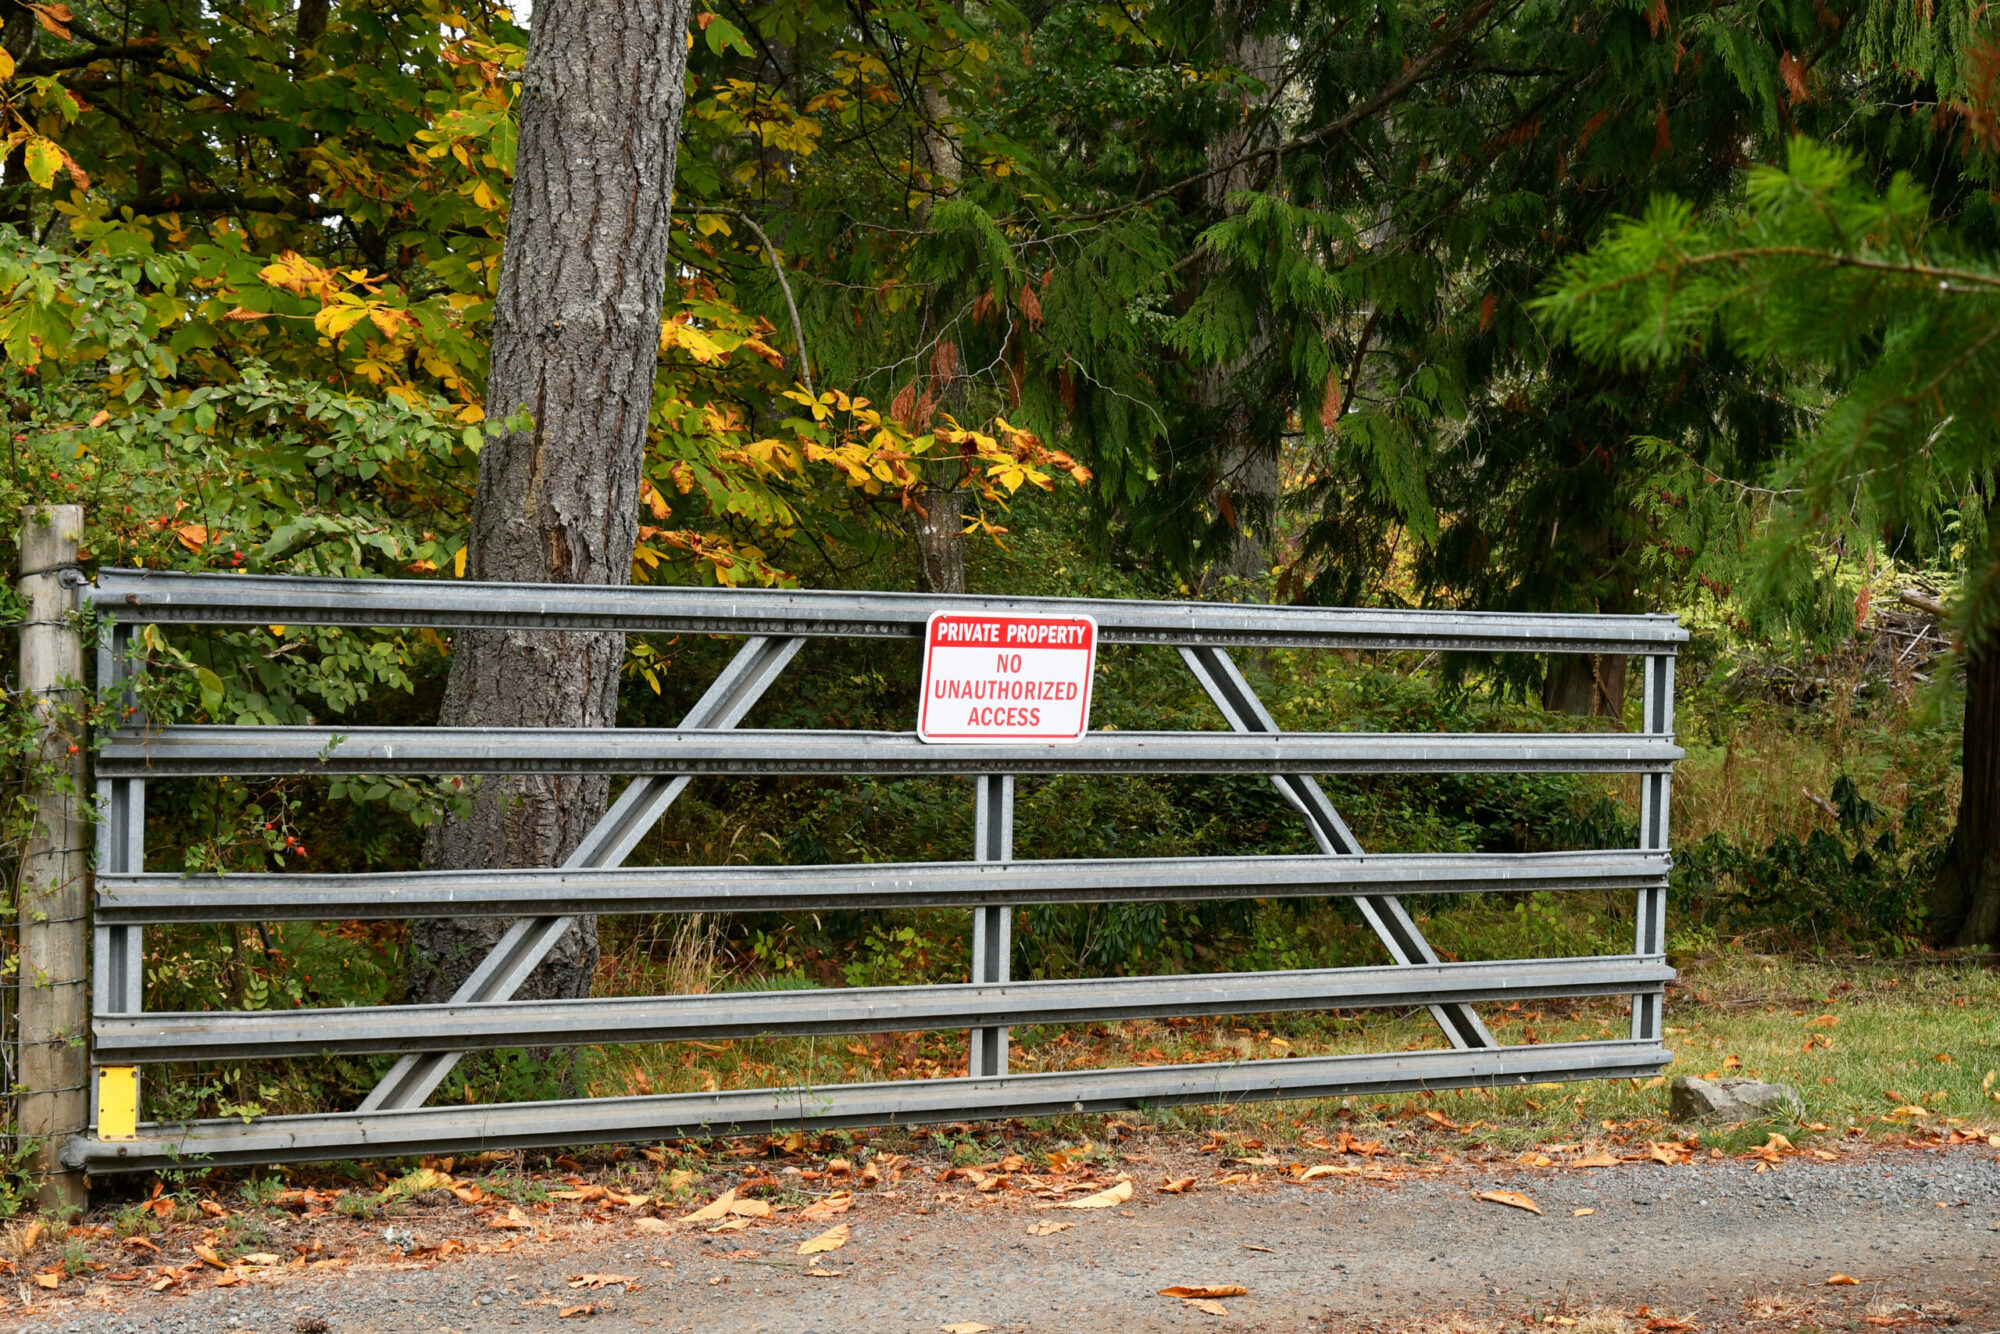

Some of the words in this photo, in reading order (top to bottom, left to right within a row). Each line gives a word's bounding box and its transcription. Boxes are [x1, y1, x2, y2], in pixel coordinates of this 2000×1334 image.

[937, 622, 1001, 643] PRIVATE
[1006, 624, 1087, 644] PROPERTY
[996, 654, 1022, 673] NO
[934, 680, 1078, 701] UNAUTHORIZED
[967, 707, 1040, 727] ACCESS
